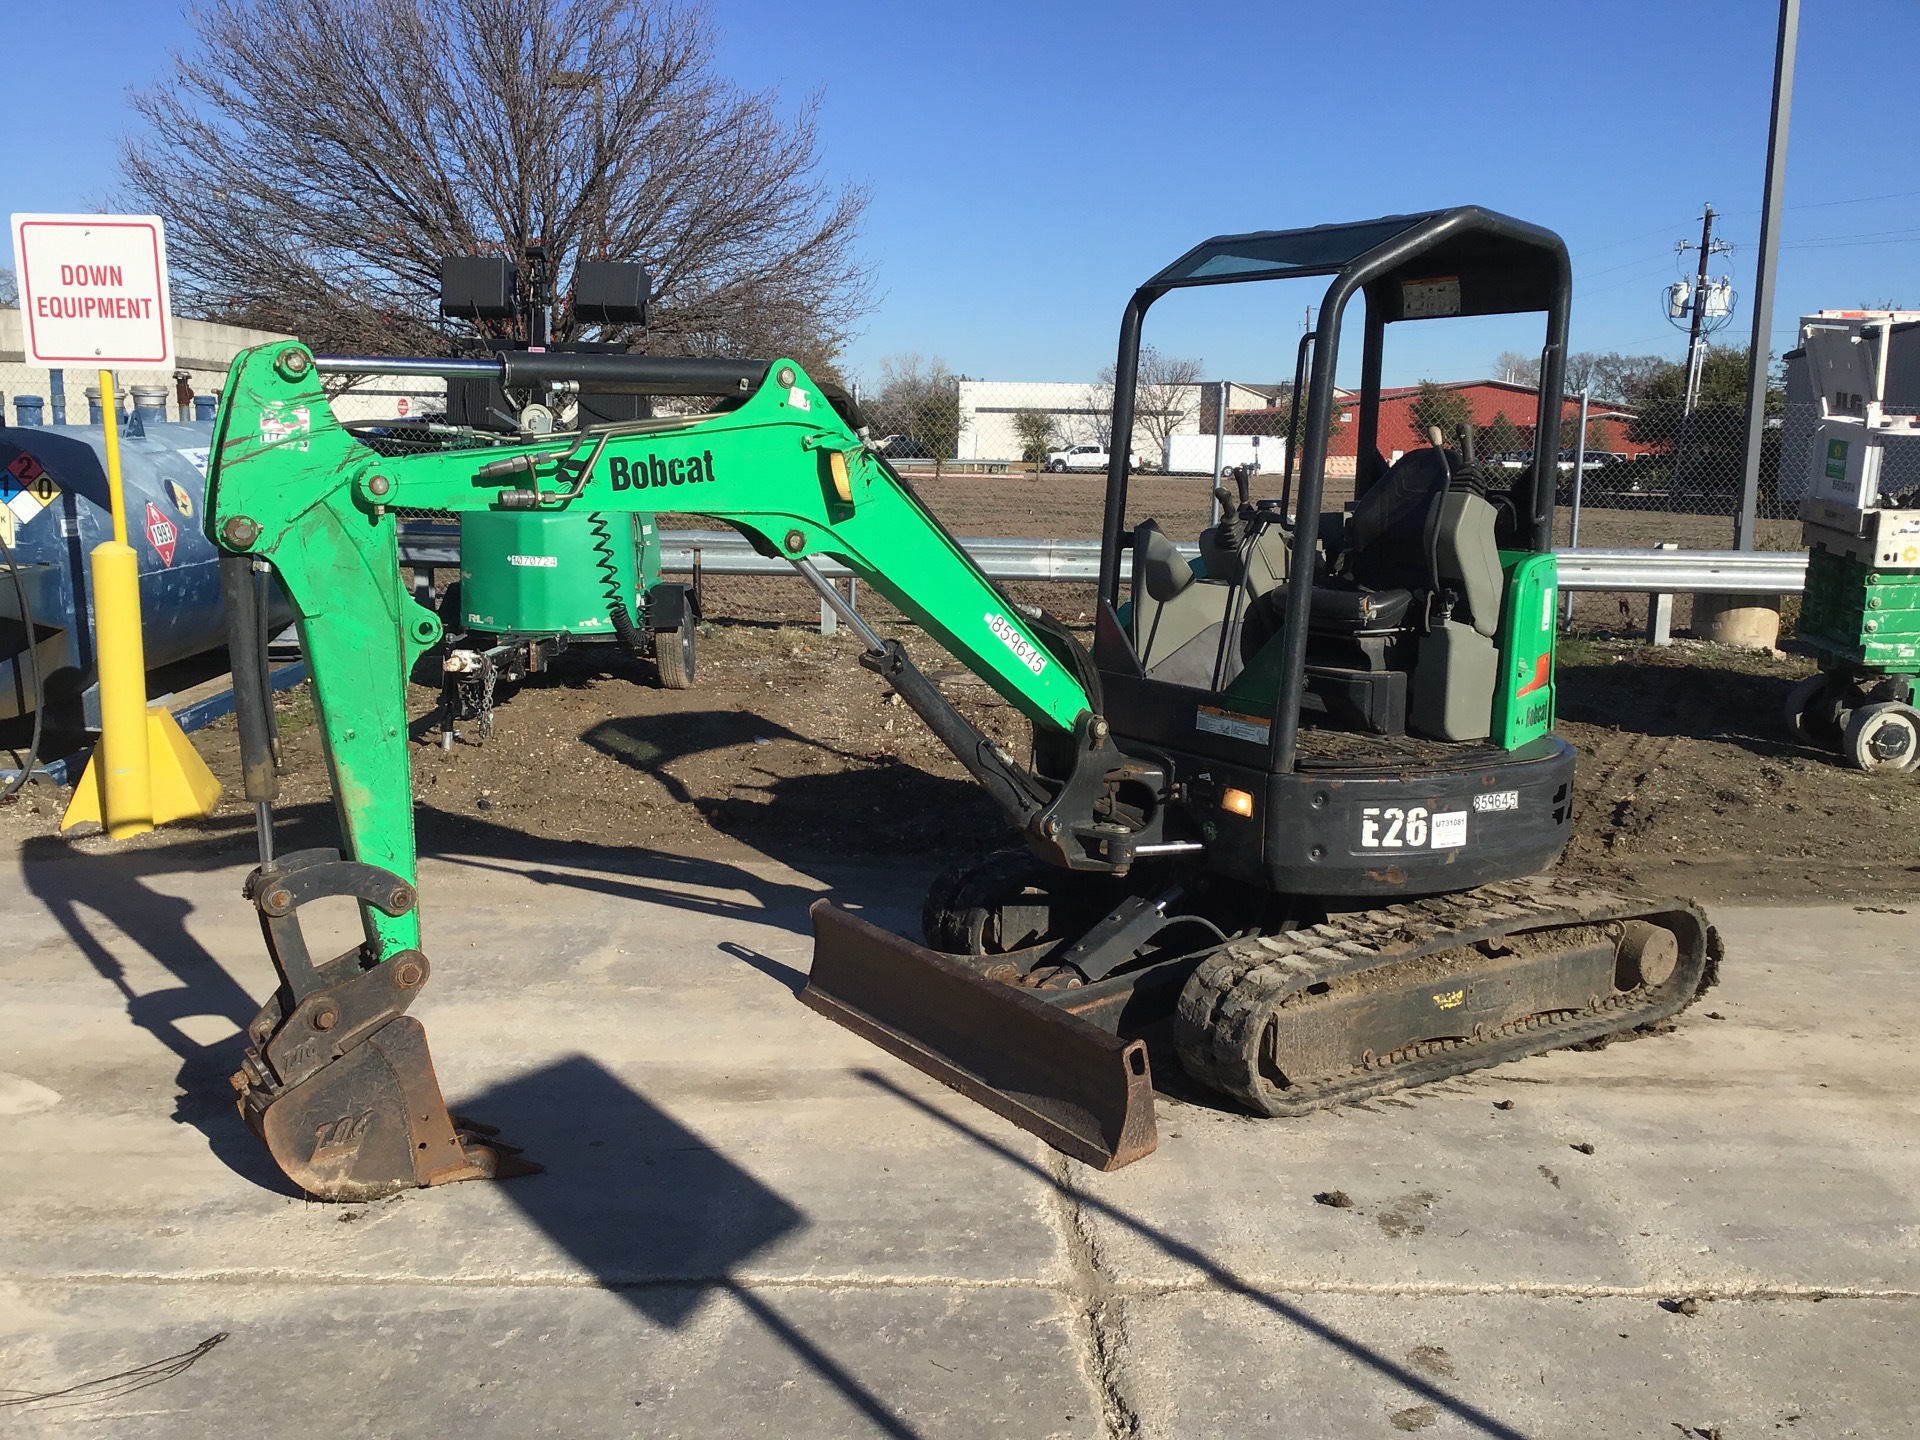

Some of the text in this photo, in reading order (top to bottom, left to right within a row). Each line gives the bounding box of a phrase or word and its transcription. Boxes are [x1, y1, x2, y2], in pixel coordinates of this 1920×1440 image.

[61, 264, 123, 287] DOWN
[37, 296, 152, 319] EQUIPMENT
[17, 456, 33, 479] 2
[609, 449, 715, 492] Bobcat
[2, 475, 9, 497] 1
[38, 477, 52, 500] 0
[152, 523, 173, 545] 1993
[165, 550, 170, 562] 3
[991, 616, 1046, 673] 859645
[1474, 793, 1517, 810] 859645
[1361, 806, 1429, 848] E26
[1435, 818, 1465, 828] U731081
